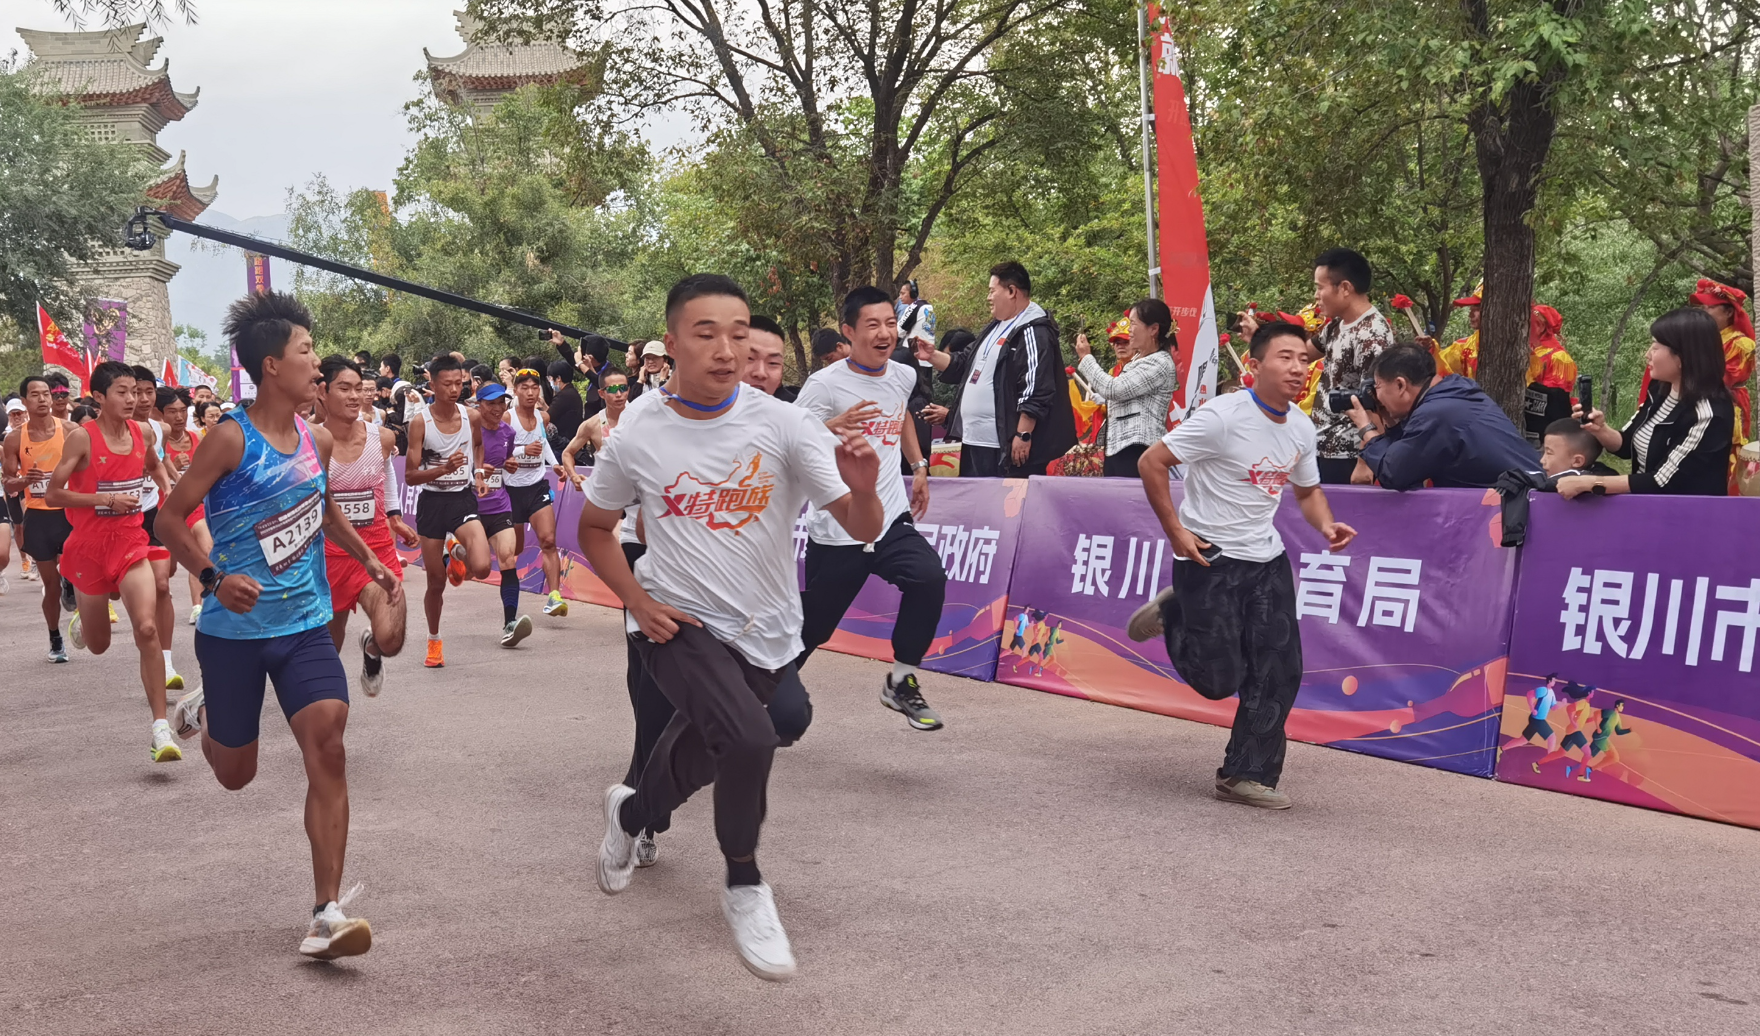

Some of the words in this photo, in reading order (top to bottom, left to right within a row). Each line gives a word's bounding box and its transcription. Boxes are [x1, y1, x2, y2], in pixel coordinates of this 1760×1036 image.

[655, 484, 775, 521] X特跑族
[273, 508, 318, 554] A2139
